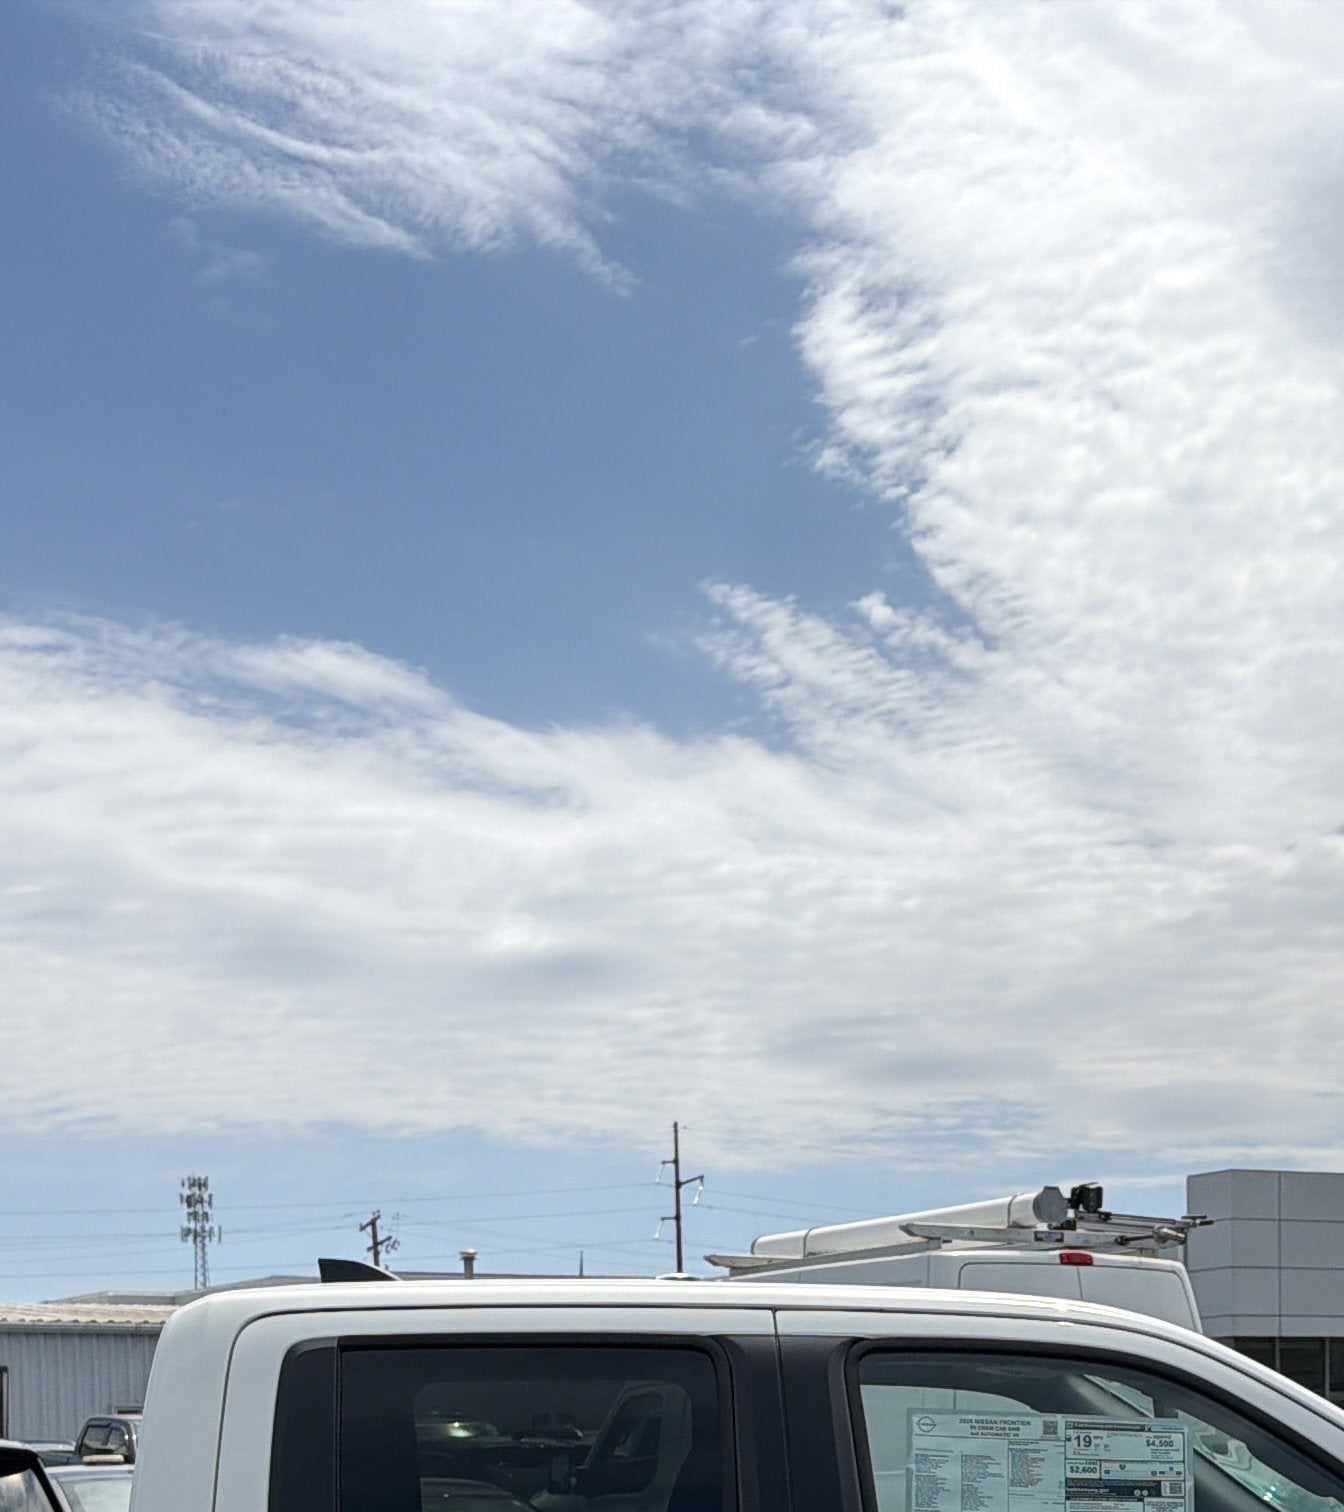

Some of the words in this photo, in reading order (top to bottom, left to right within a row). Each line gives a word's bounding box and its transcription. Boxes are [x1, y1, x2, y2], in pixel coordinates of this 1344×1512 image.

[974, 1418, 998, 1426] NISSAN
[999, 1419, 1031, 1427] FRONTIER
[1074, 1434, 1093, 1448] 19
[1145, 1439, 1174, 1448] $4,500
[1069, 1465, 1097, 1474] $2,600
